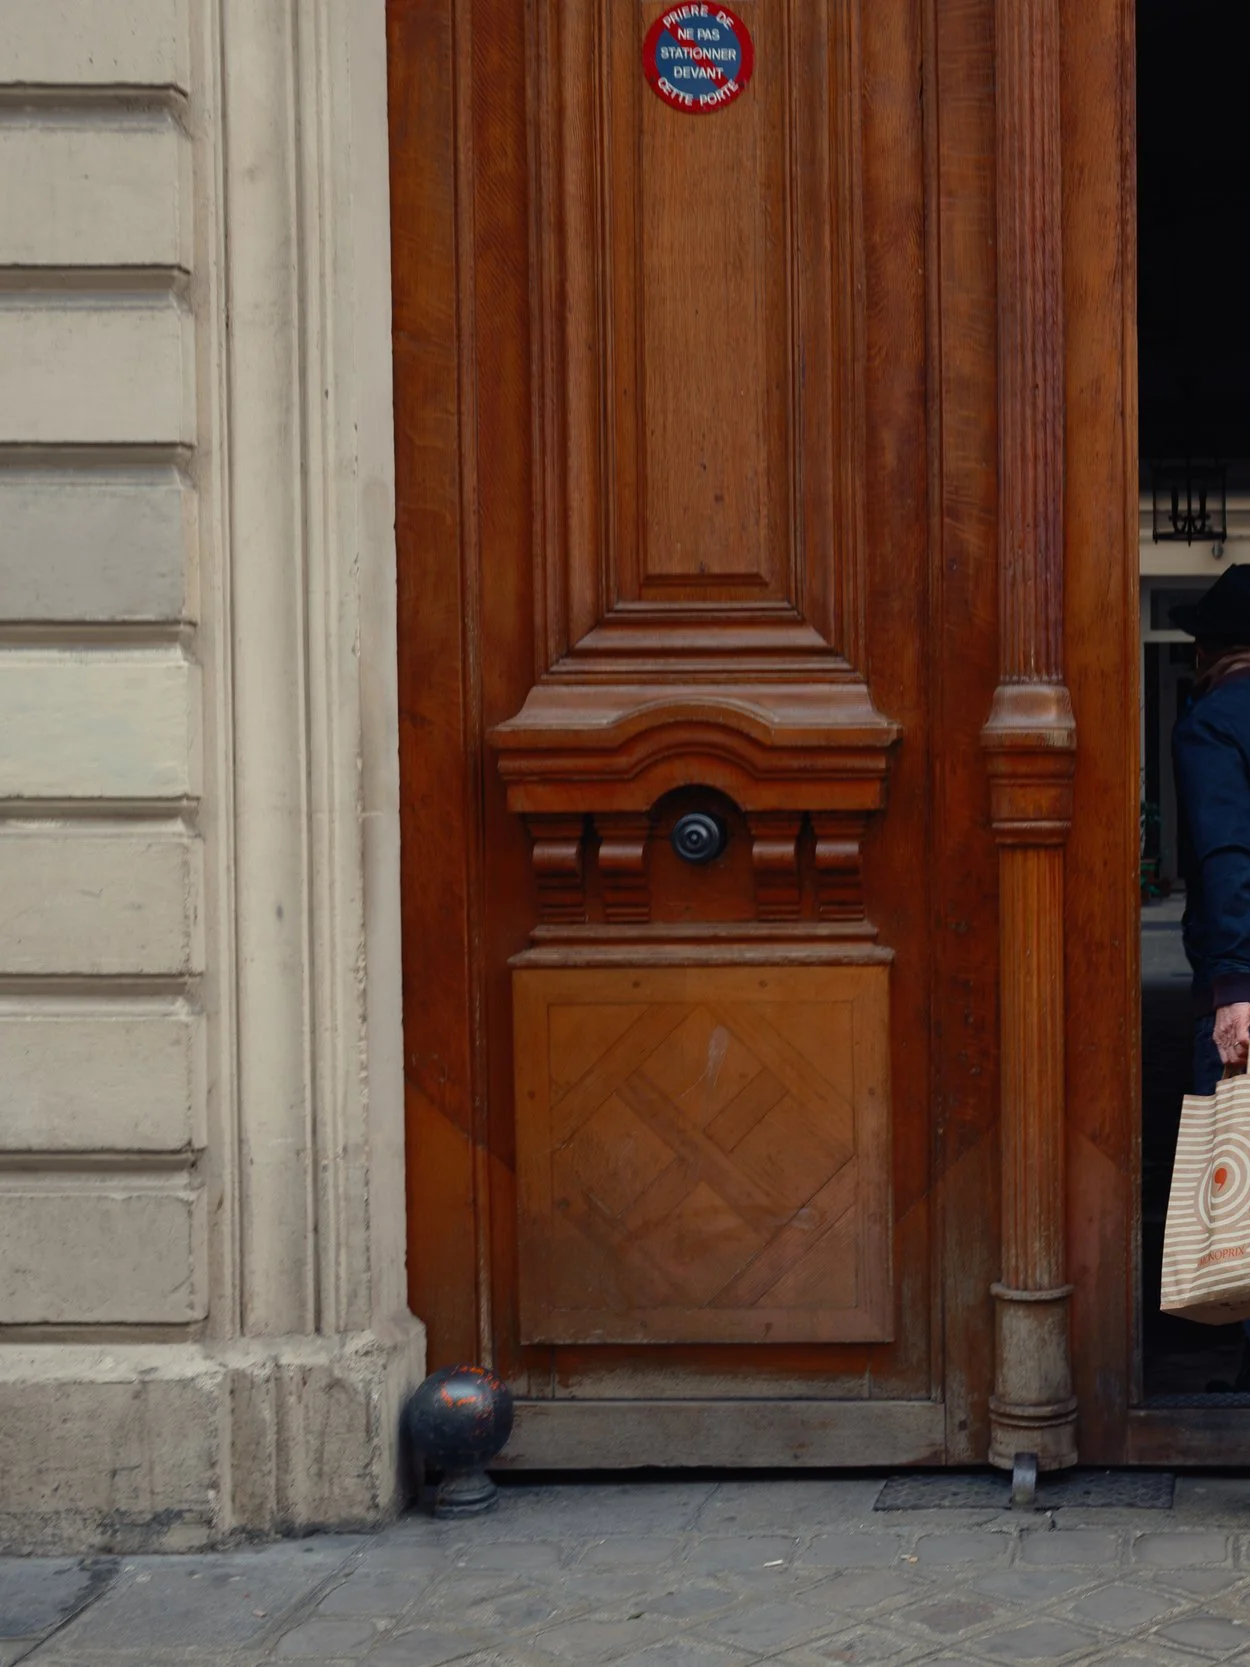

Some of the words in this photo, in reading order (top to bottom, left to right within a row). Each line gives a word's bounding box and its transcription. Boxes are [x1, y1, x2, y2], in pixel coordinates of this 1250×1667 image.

[662, 4, 708, 28] PRIERE
[716, 11, 734, 30] DE
[677, 28, 694, 40] NE
[697, 28, 720, 41] PAS
[660, 46, 736, 61] STATIONNER
[673, 66, 724, 79] DEVANT
[658, 77, 694, 106] CETTE
[699, 78, 739, 107] PORTE
